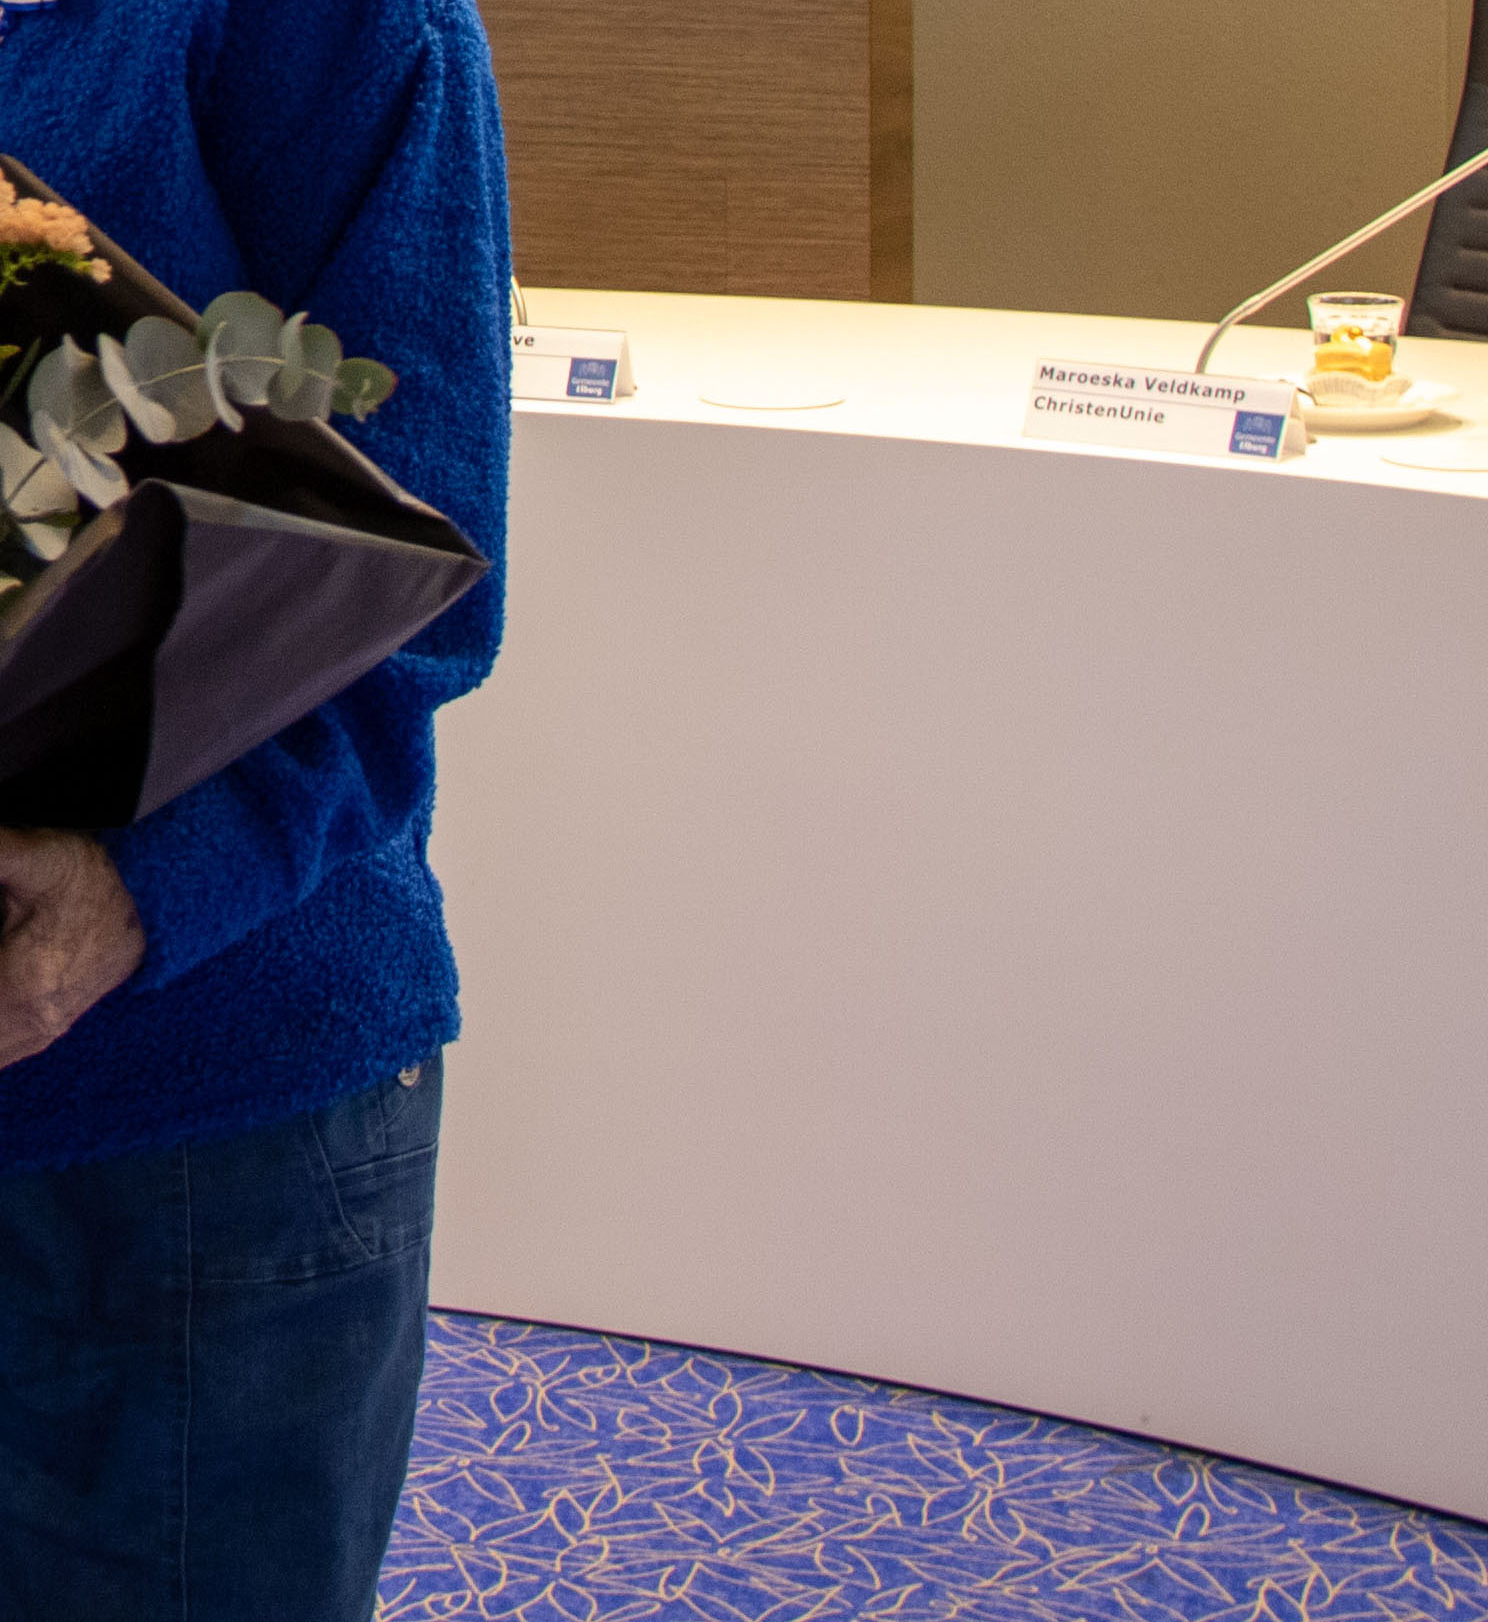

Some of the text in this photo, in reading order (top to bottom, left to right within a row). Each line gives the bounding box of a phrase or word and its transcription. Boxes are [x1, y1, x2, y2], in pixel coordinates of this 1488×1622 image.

[1040, 366, 1246, 404] Maroeska Veldkamp
[1034, 396, 1165, 424] ChristenUnie
